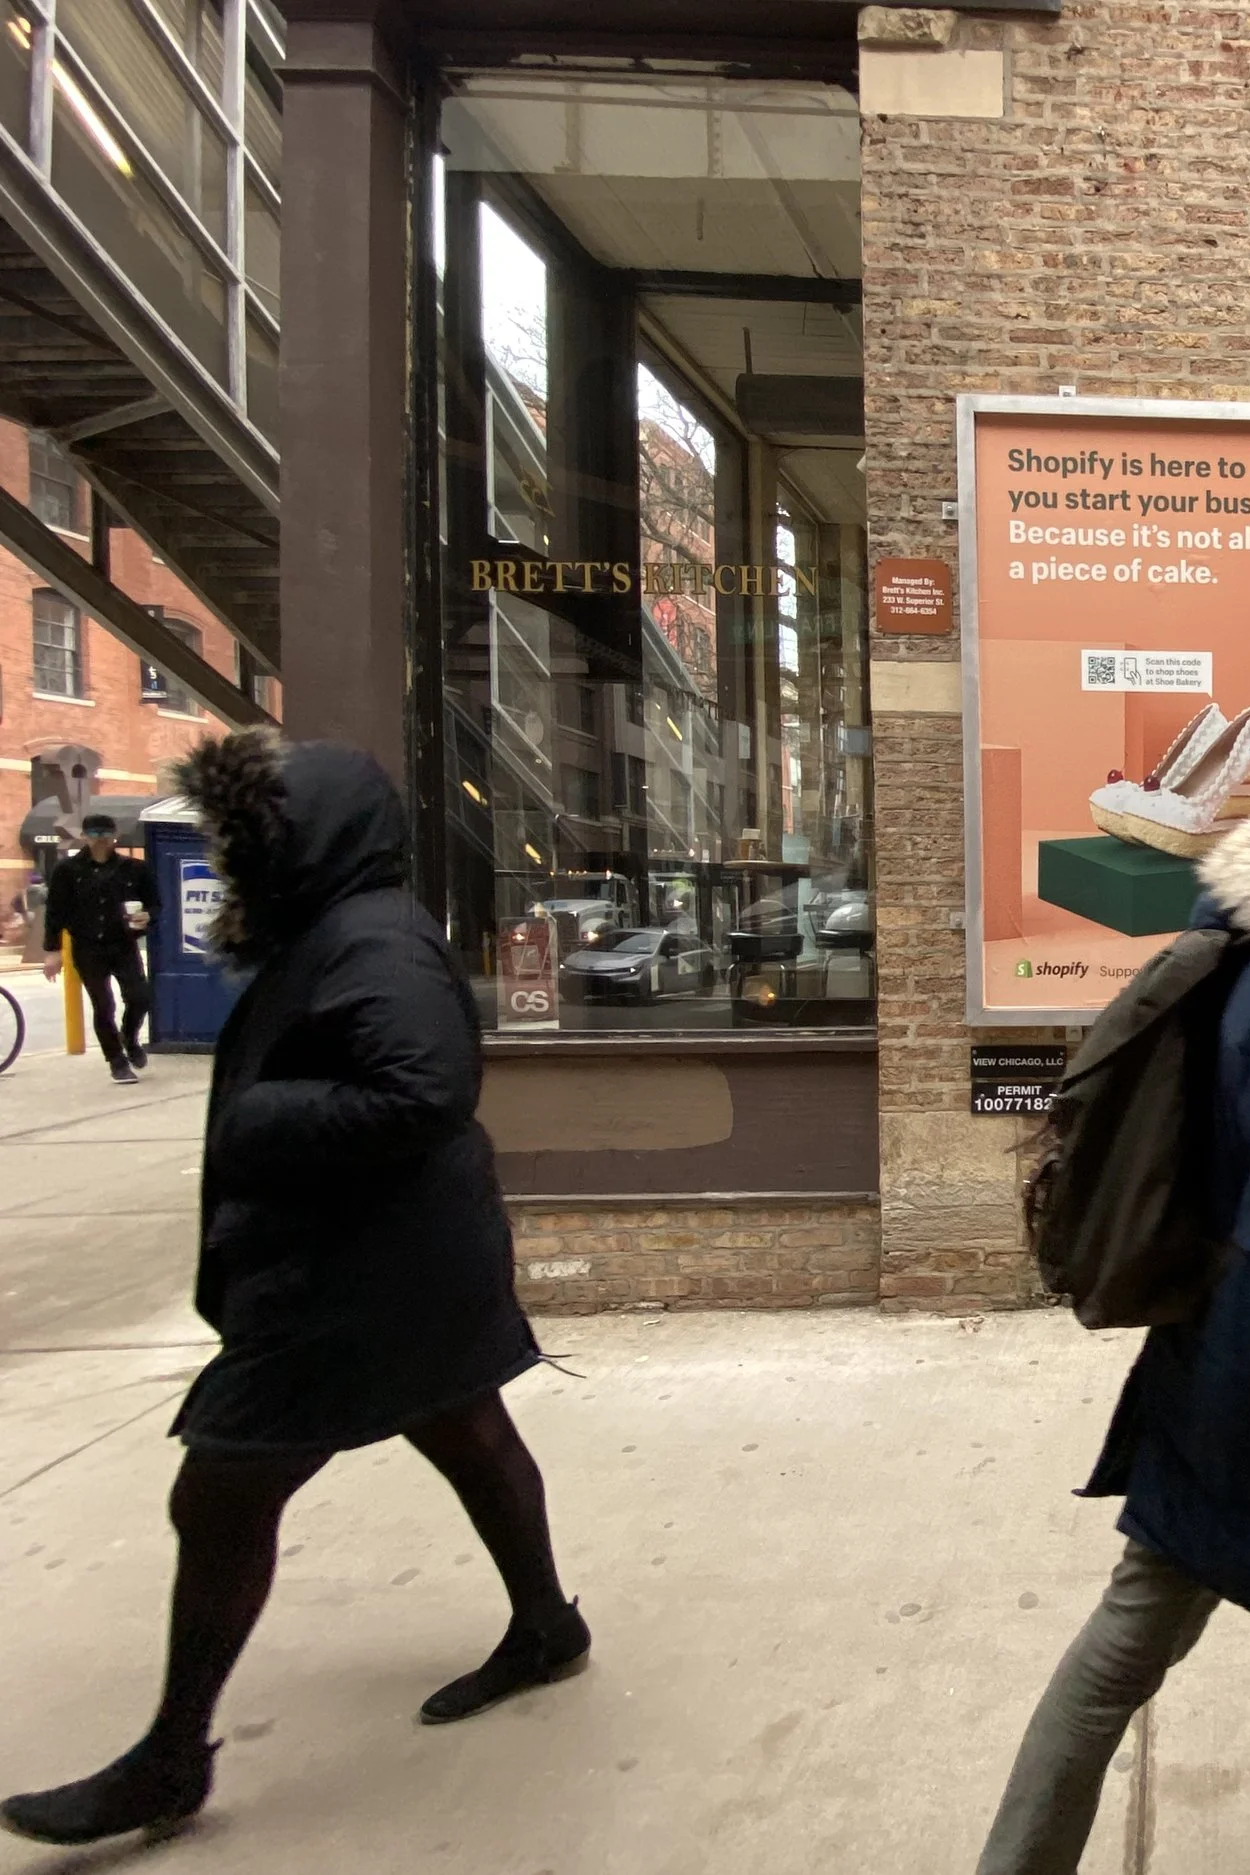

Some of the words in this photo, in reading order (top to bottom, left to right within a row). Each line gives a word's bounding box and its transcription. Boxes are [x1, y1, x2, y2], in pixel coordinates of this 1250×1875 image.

[1007, 449, 1114, 479] Shopify
[1122, 453, 1143, 476] is
[1150, 453, 1211, 478] here
[1218, 458, 1245, 478] to
[1008, 490, 1058, 512] you
[1065, 489, 1131, 512] start
[1137, 495, 1198, 516] your
[1009, 521, 1125, 547] Because
[1177, 527, 1222, 550] not
[1009, 562, 1024, 579] a
[1032, 557, 1106, 584] piece
[1114, 558, 1142, 582] of
[1148, 561, 1218, 584] cake.
[470, 560, 632, 593] BRETT'S
[644, 564, 819, 597] KITCHEN
[892, 577, 922, 585] Managed
[906, 587, 931, 595] Kitchen
[906, 597, 933, 605] Superior
[1182, 658, 1201, 666] code
[1156, 668, 1174, 677] shop
[1176, 668, 1198, 676] shoes
[1176, 679, 1201, 687] Bakery
[1036, 962, 1089, 978] shopify
[973, 1058, 996, 1066] VIEW
[999, 1058, 1043, 1066] CHICAGO,
[998, 1086, 1042, 1095] PERMIT
